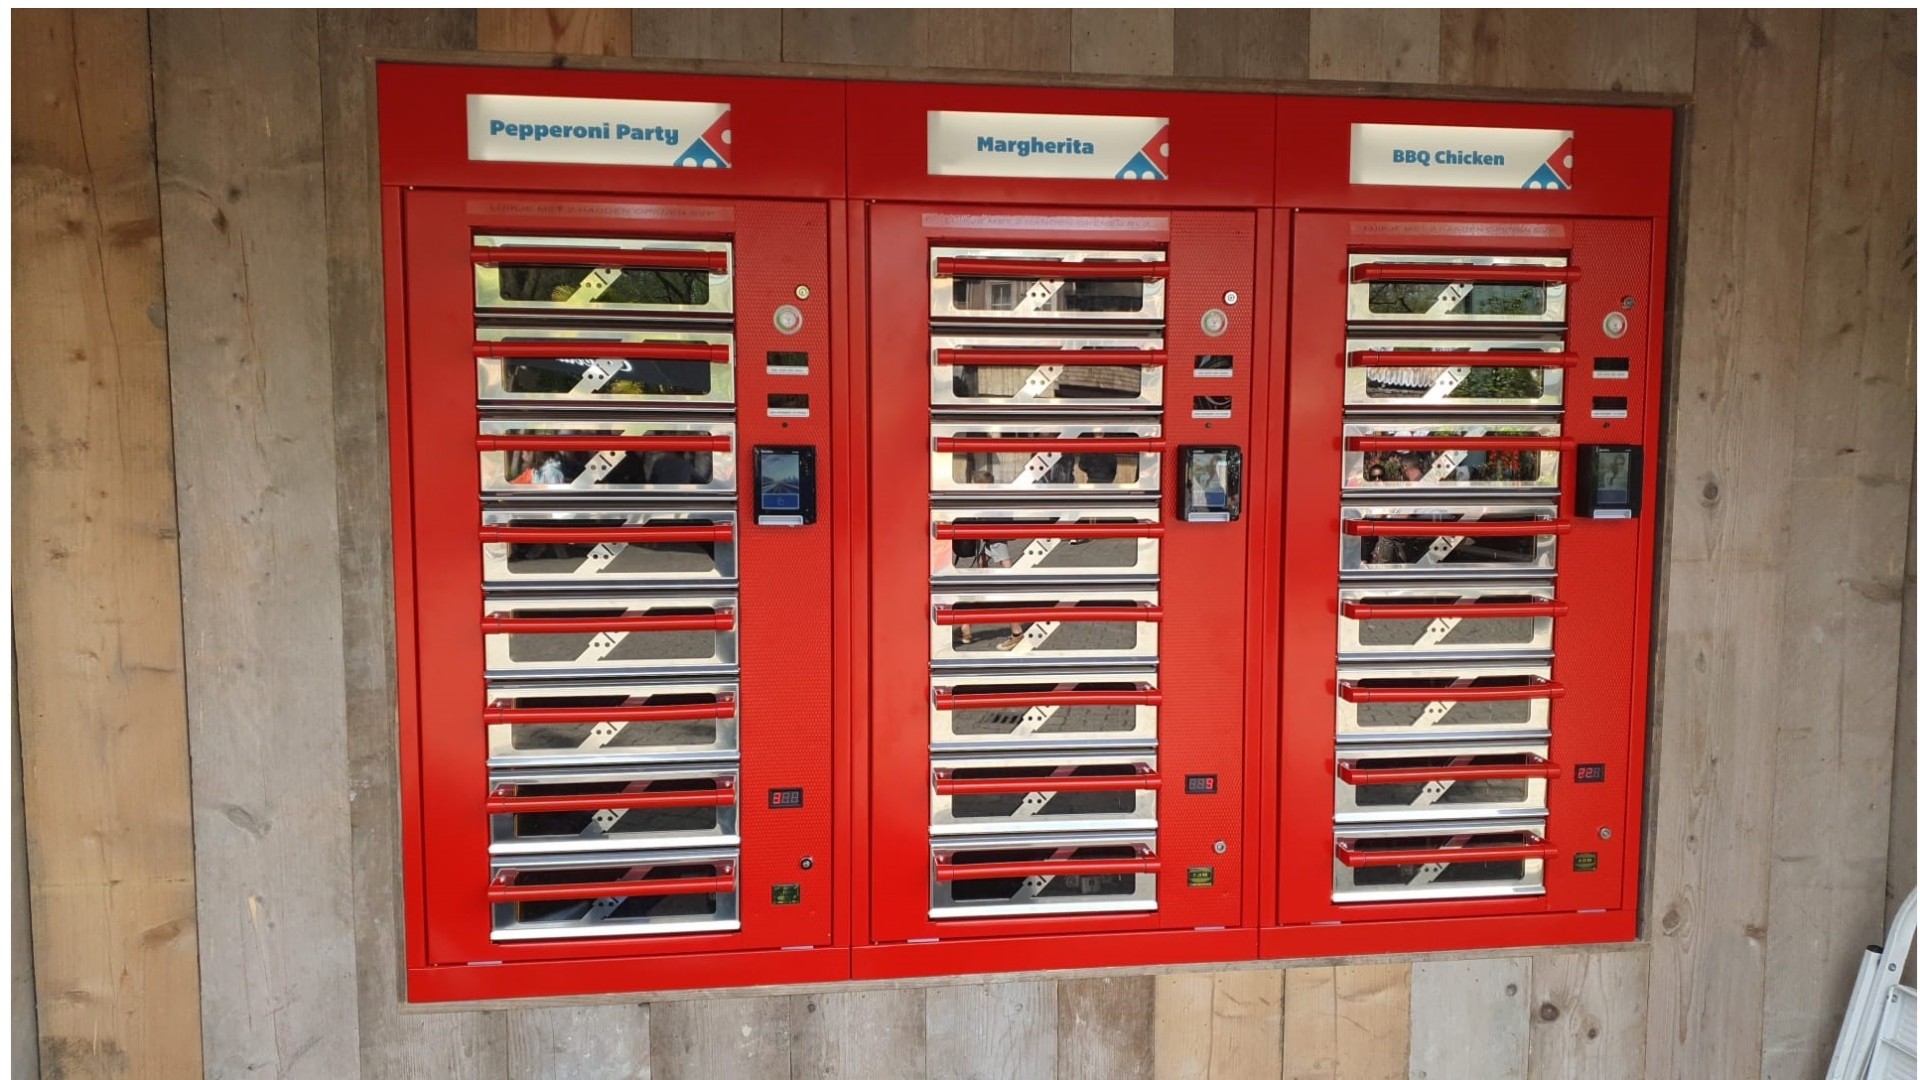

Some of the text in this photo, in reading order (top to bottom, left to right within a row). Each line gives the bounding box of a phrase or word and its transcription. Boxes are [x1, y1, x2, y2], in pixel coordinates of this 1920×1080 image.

[490, 119, 679, 146] Pepperoni Party
[977, 136, 1094, 157] Margherita
[1393, 149, 1505, 167] BBQ Chicken
